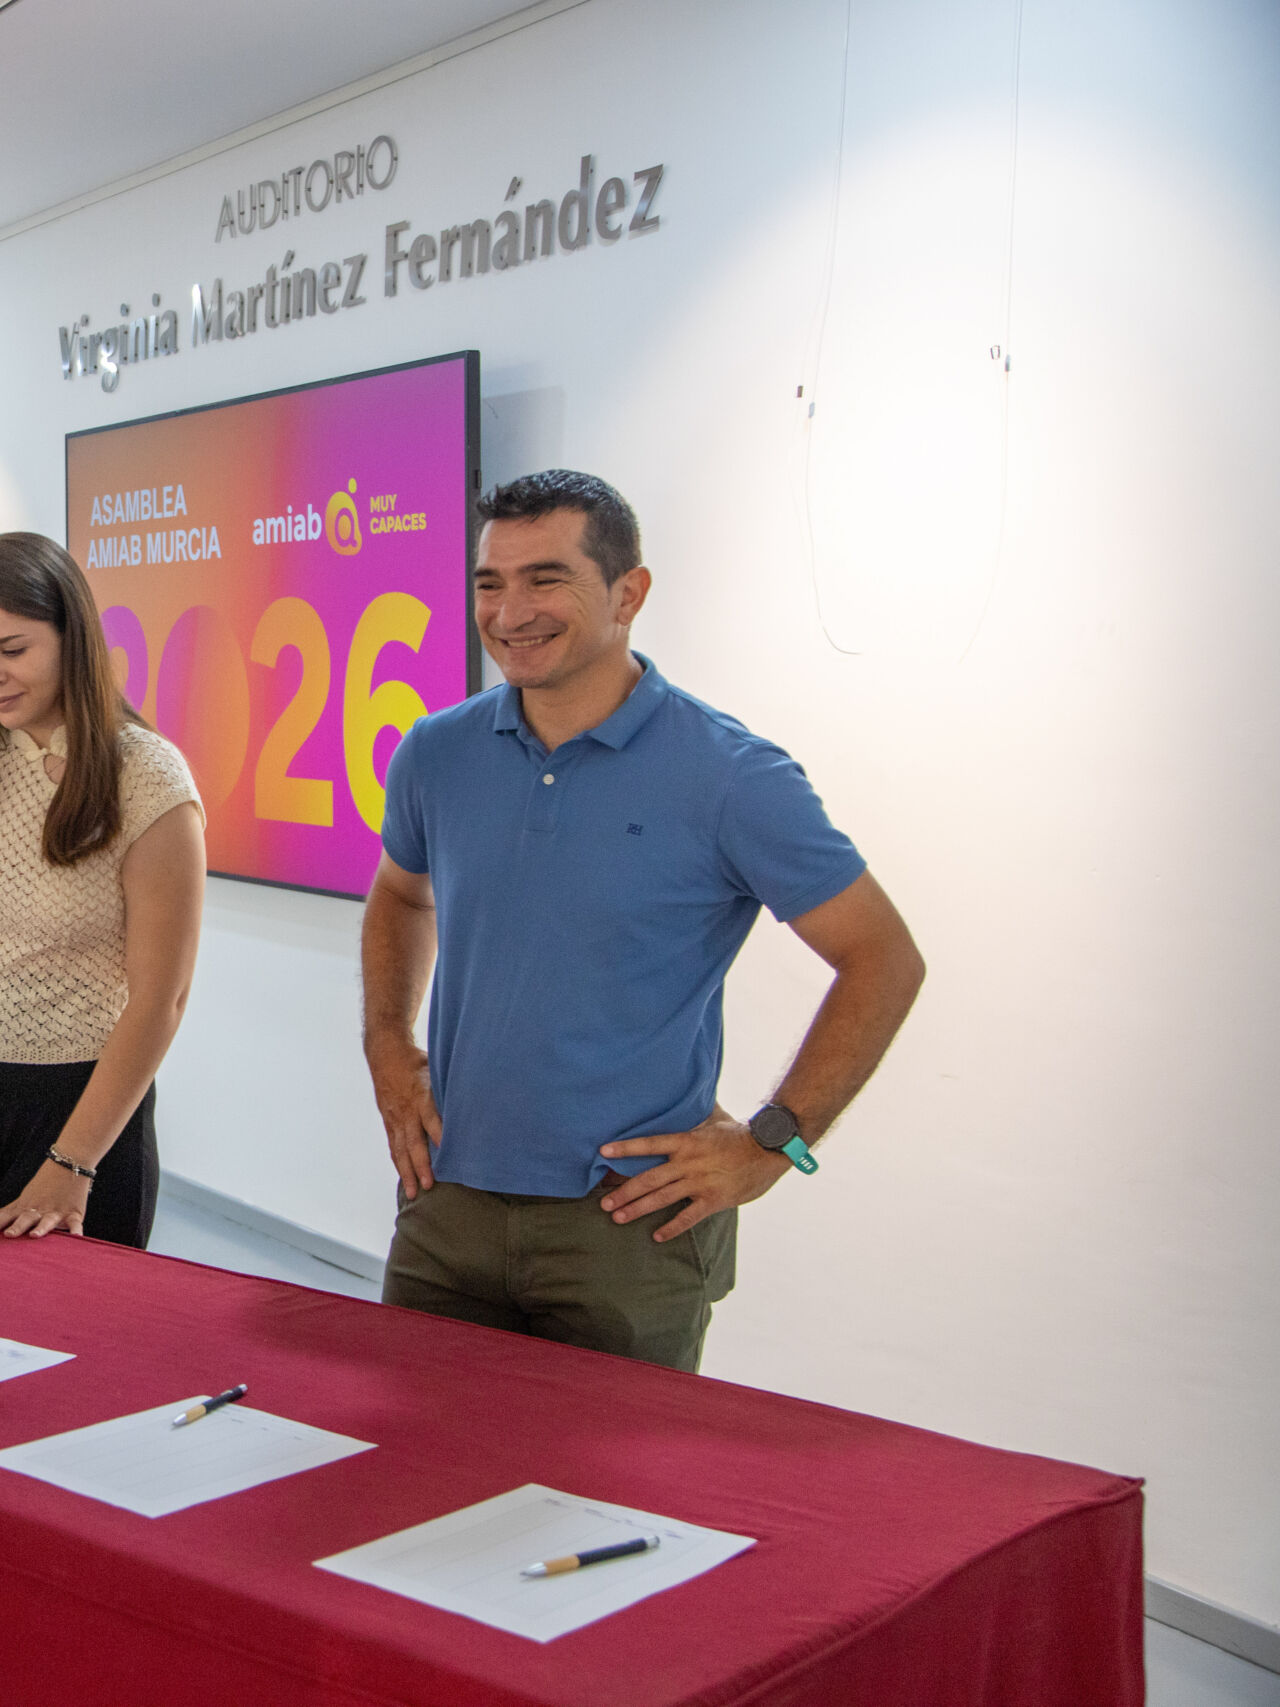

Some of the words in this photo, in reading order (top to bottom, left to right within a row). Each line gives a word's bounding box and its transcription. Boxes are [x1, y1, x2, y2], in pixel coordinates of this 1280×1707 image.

[215, 134, 399, 244] AUDITORIO
[58, 293, 179, 393] Virginia
[191, 250, 367, 348] Martínez
[384, 153, 664, 299] Fernández
[90, 484, 188, 527] ASAMBLEA
[253, 504, 322, 546] amiab
[370, 494, 397, 513] MUY
[370, 512, 427, 535] CAPACES
[86, 533, 143, 569] AMIAB
[146, 526, 222, 563] MURCIA
